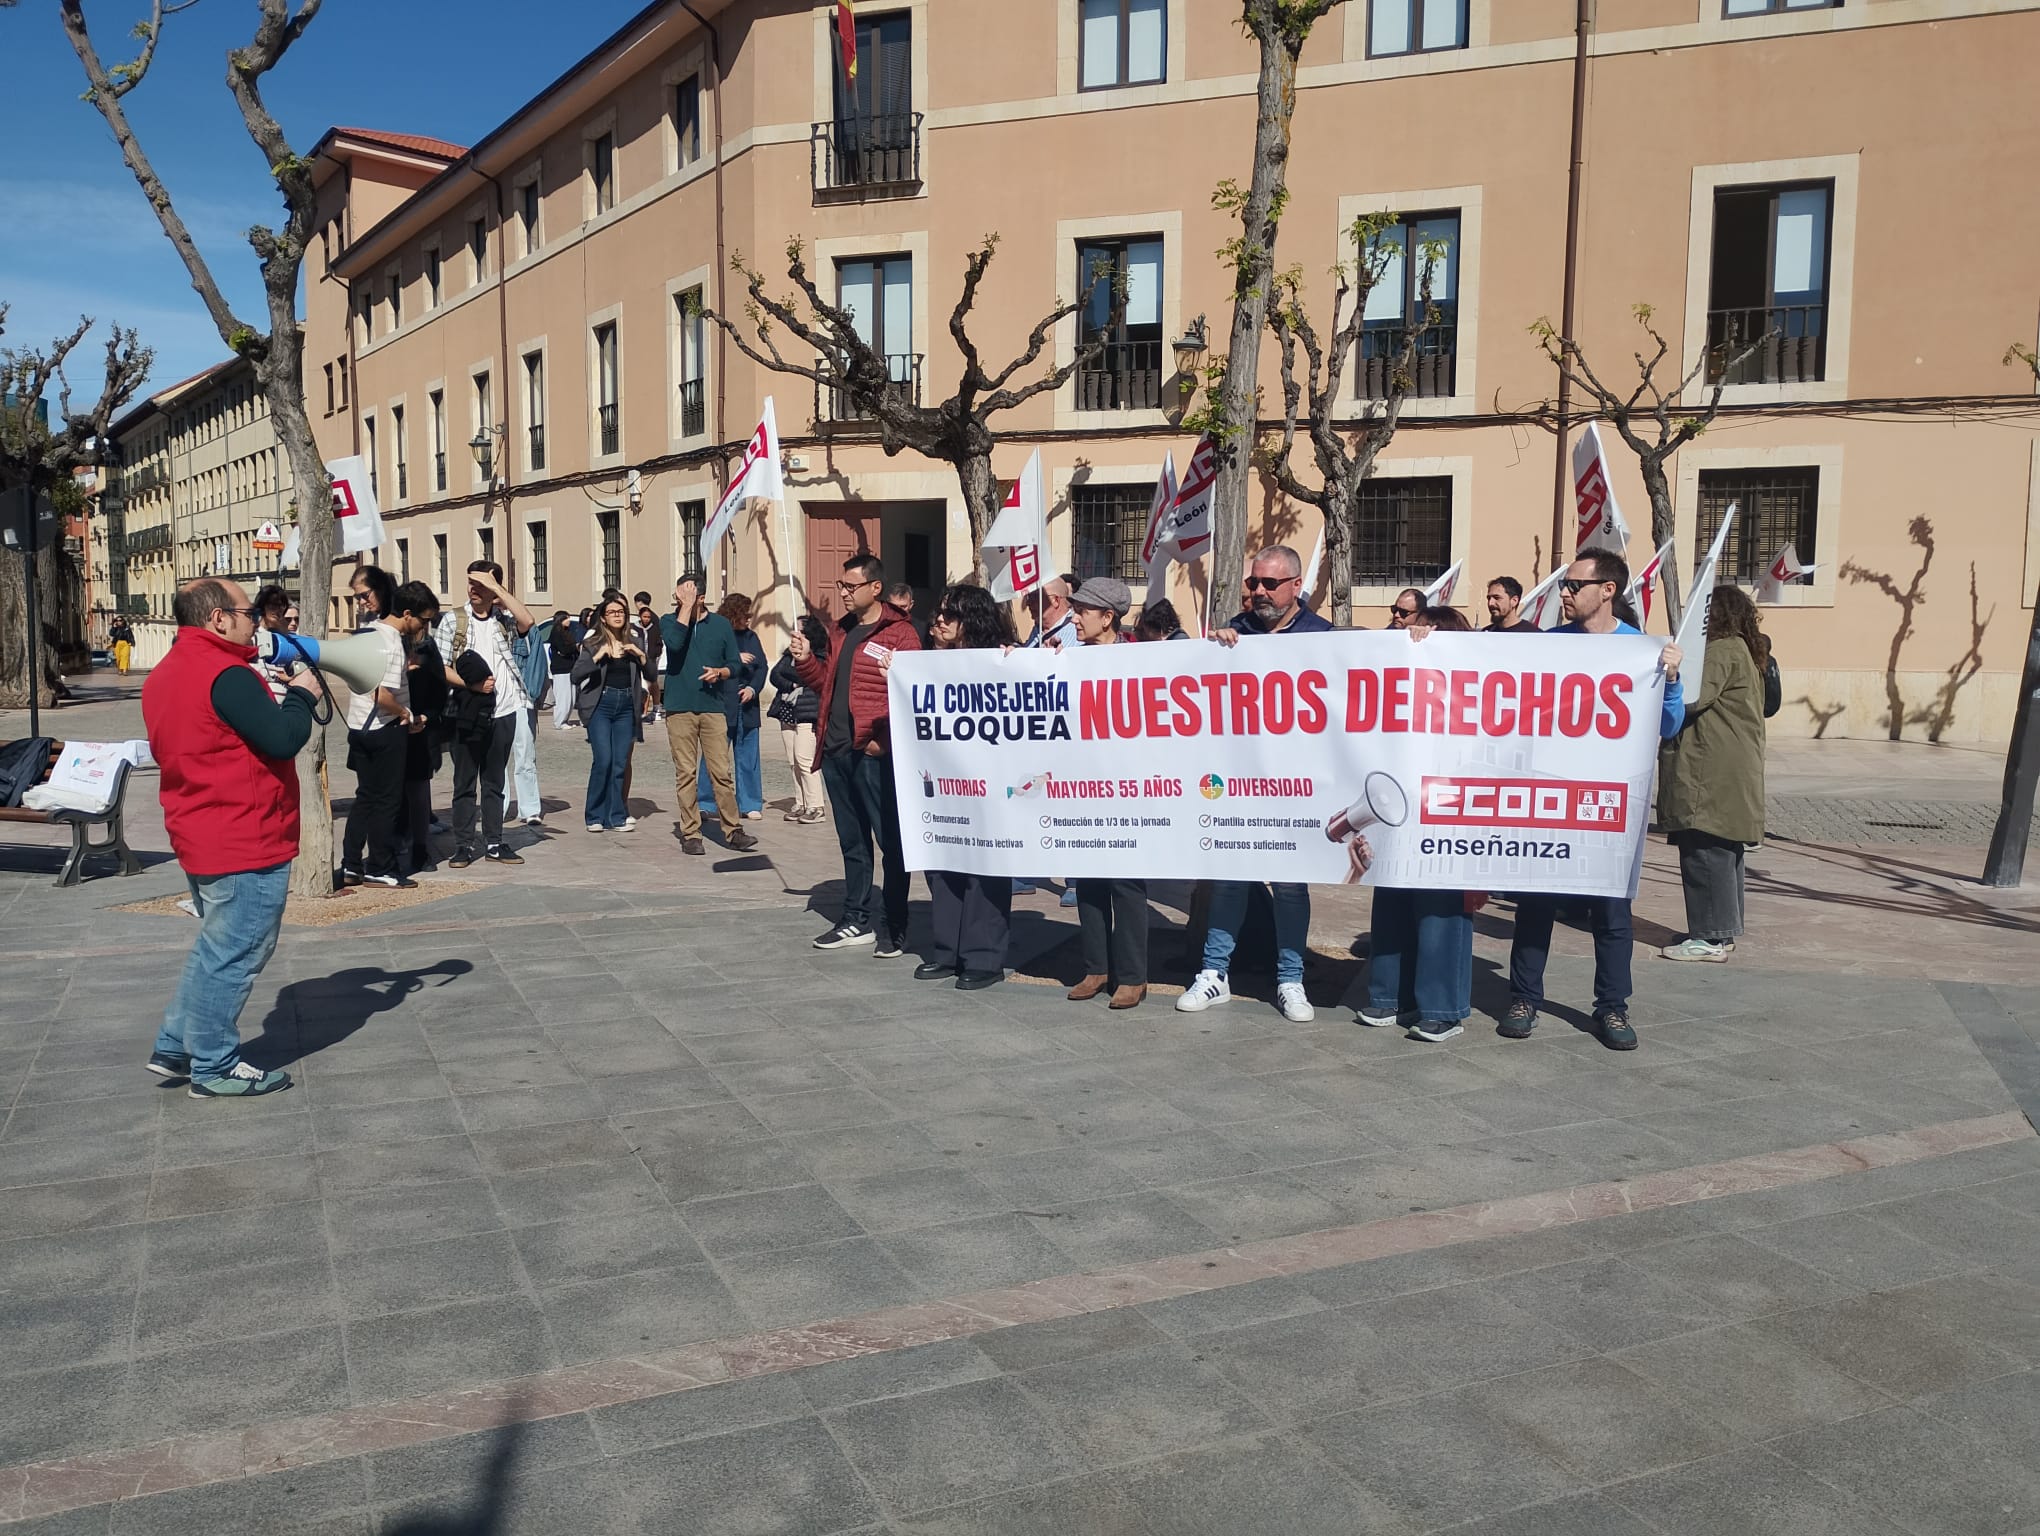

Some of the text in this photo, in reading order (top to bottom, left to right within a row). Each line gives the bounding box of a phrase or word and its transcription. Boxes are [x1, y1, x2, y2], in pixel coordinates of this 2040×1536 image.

[1175, 501, 1207, 528] León
[912, 673, 1069, 714] LA CONSEJERÍA
[1080, 667, 1633, 740] NUESTROS DERECHOS
[915, 715, 1072, 745] BLOQUEA
[937, 777, 987, 797] TUTORIAS
[1046, 774, 1183, 799] MAYORES 55 AÑOS
[1227, 778, 1313, 797] DIVERSIDAD
[1428, 784, 1568, 820] CCOO
[932, 814, 970, 825] Remuneradas
[1053, 816, 1171, 828] Reducción de 1/3 de la jornada
[1213, 816, 1321, 828] Plantilla estructural estable
[934, 834, 963, 846] Reducción
[964, 836, 970, 846] de
[977, 838, 993, 848] horas
[995, 839, 1023, 848] lectivas
[1054, 838, 1137, 849] Sin reducción salarial
[1214, 839, 1297, 851] Recursos suficientes
[1421, 835, 1571, 860] enseñanza
